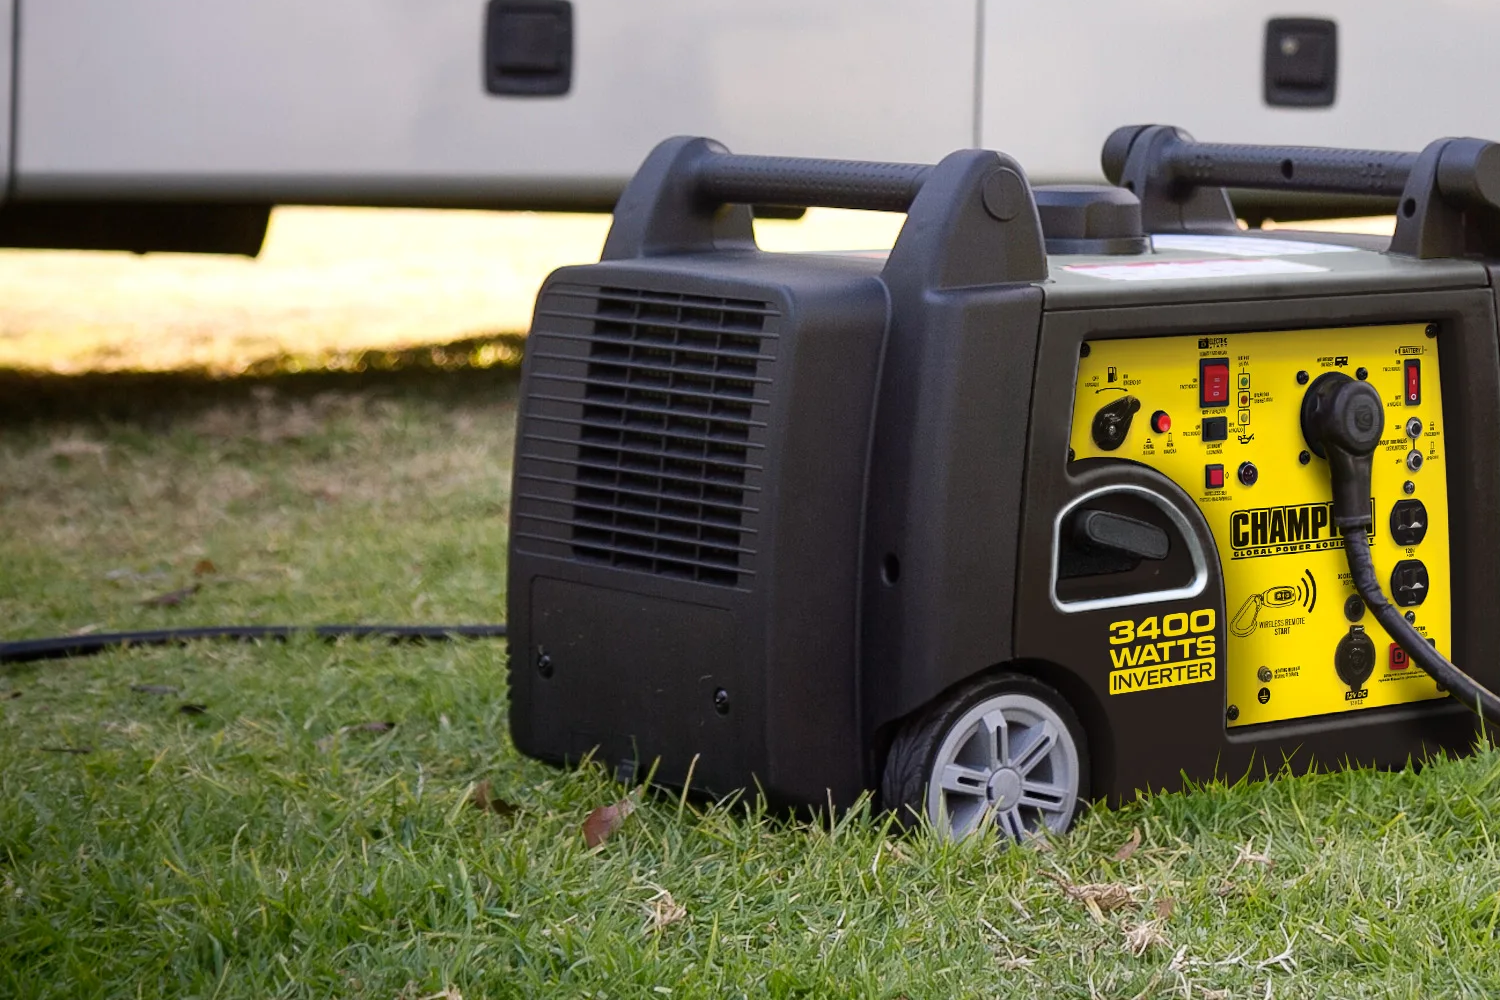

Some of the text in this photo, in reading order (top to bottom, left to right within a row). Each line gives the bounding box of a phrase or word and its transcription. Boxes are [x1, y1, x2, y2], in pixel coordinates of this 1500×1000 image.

[1232, 501, 1373, 547] CHAMPI
[1233, 548, 1273, 557] GLOBAL
[1276, 543, 1311, 553] POWER
[1109, 608, 1216, 645] 3400
[1259, 617, 1306, 629] WIRELESS REMOTE
[1274, 627, 1290, 636] START
[1109, 635, 1216, 669] WATTS
[1113, 662, 1213, 691] INVERTER
[1346, 690, 1367, 700] 12V DC
